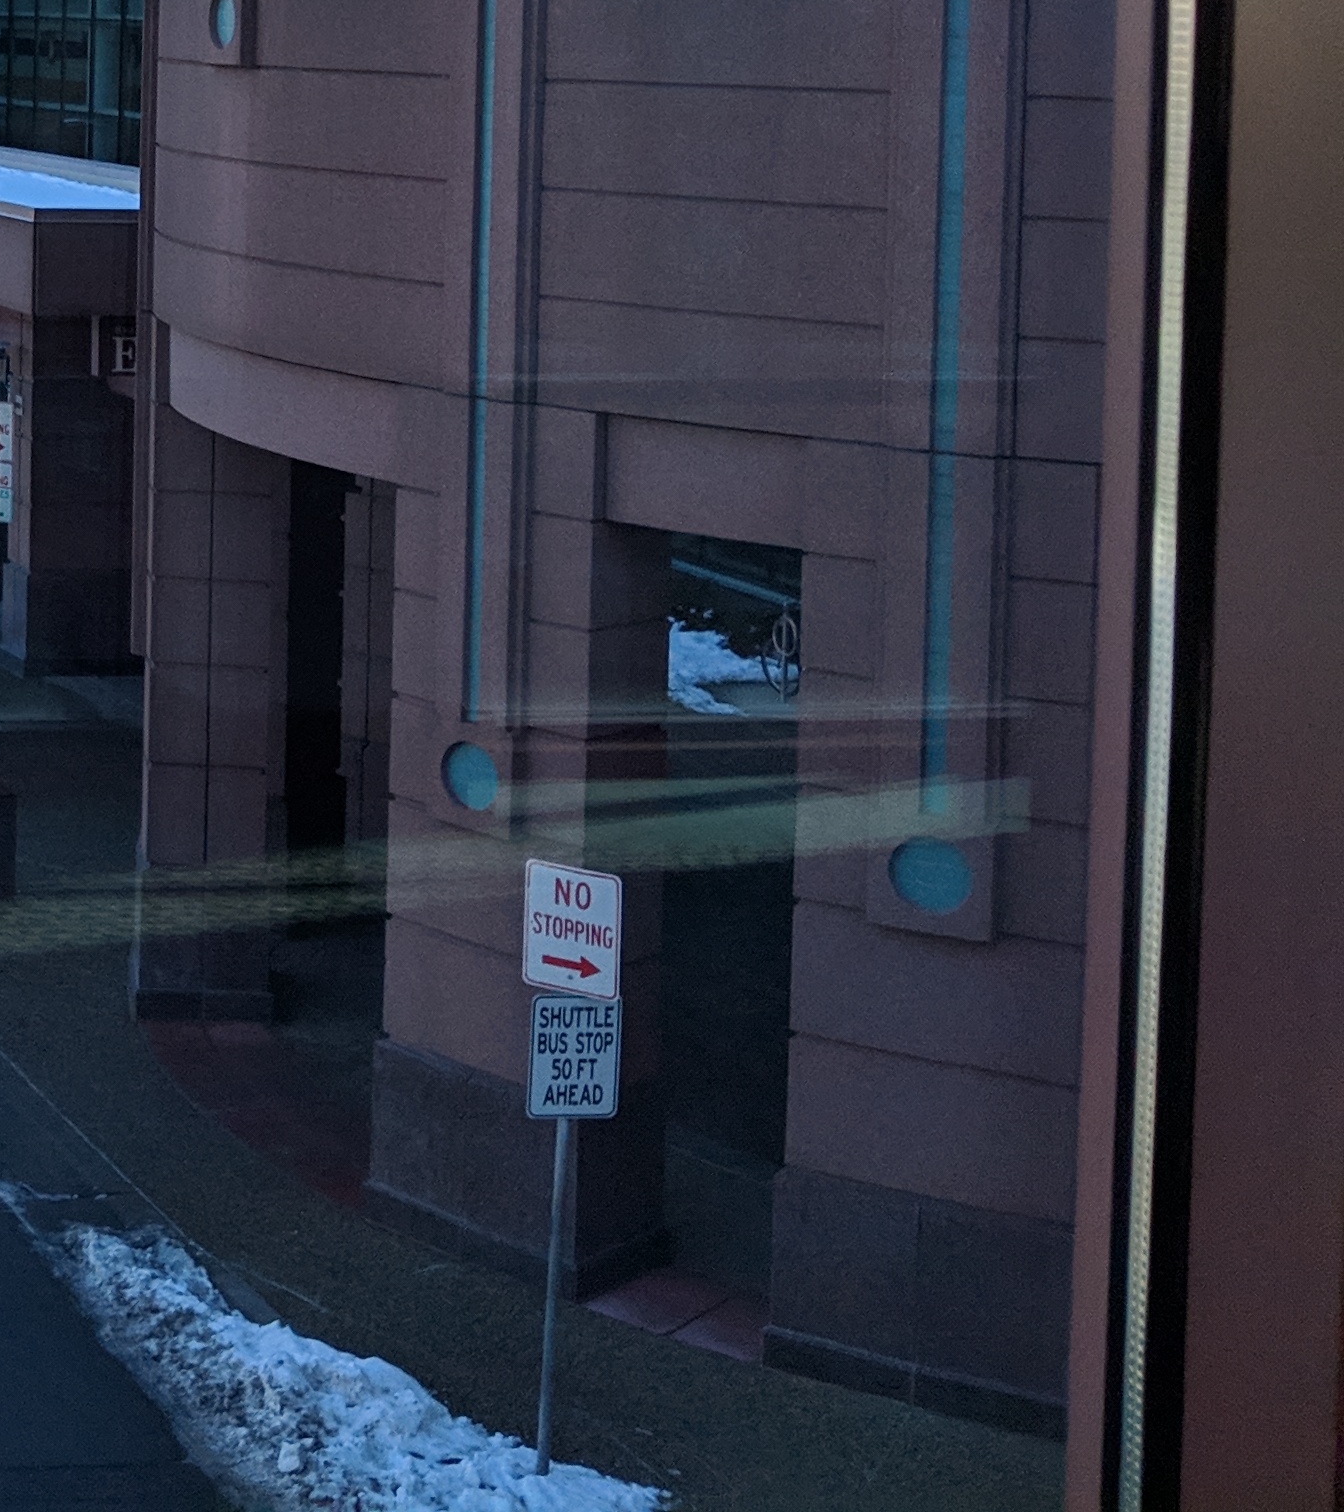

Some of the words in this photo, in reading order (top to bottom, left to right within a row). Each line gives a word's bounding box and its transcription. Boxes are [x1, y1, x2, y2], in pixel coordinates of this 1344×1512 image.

[554, 876, 592, 911] NO
[532, 911, 613, 949] STOPPING
[539, 1006, 615, 1029] SHUTTLE
[537, 1032, 568, 1055] BUS
[575, 1032, 614, 1055] STOP
[551, 1057, 573, 1081] 50
[576, 1058, 598, 1080] FT
[542, 1083, 604, 1107] AHEAD
